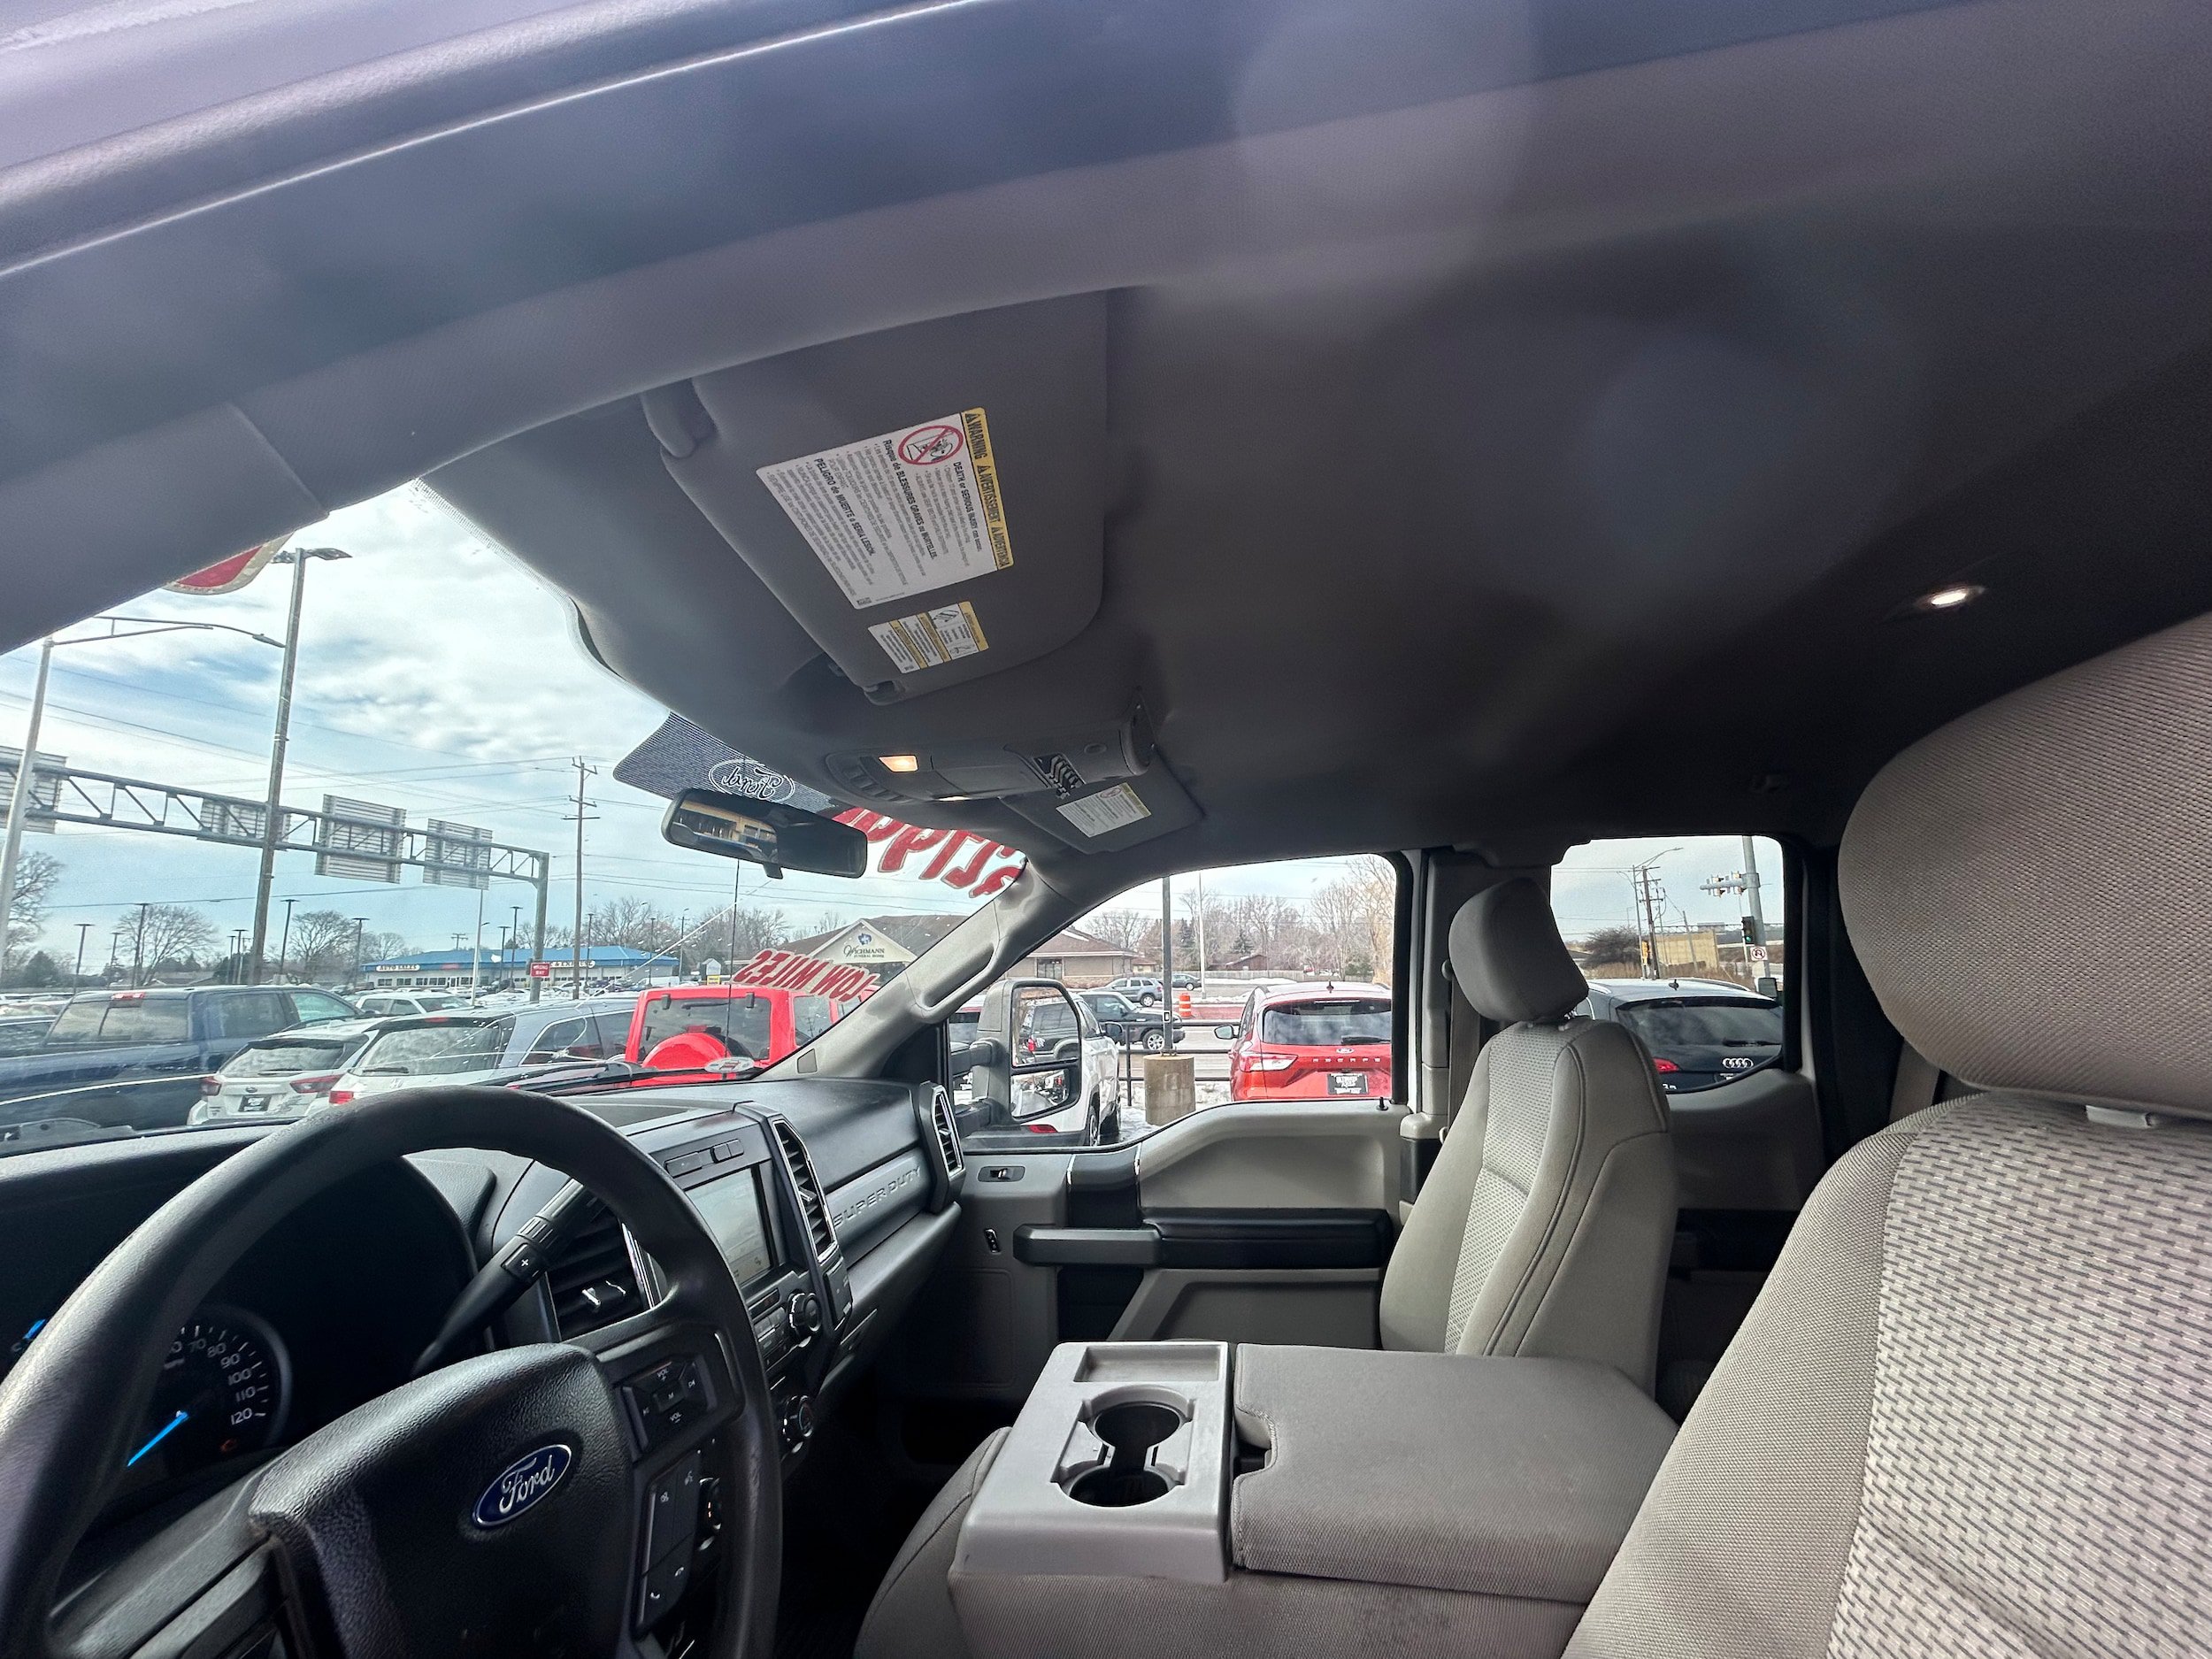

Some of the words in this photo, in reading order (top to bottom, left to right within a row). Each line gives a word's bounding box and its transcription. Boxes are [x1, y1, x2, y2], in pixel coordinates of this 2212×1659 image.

[966, 419, 988, 460] WARNING
[881, 438, 899, 462] Risque
[812, 457, 836, 486] PELIGRO
[891, 461, 902, 471] de
[952, 460, 965, 482] DEATH
[829, 485, 841, 495] de
[895, 470, 916, 504] BLESSURES
[834, 493, 856, 518] MUERTE
[832, 1187, 887, 1229] SUPER
[887, 1165, 921, 1194] DUTY
[188, 1338, 207, 1353] 70
[207, 1342, 227, 1358] 80
[220, 1353, 241, 1370] 90
[227, 1367, 252, 1386] 100
[657, 1368, 670, 1378] VOL
[235, 1386, 257, 1403] 110
[231, 1407, 253, 1426] 120
[670, 1411, 682, 1422] VOL
[499, 1454, 556, 1514] Ford
